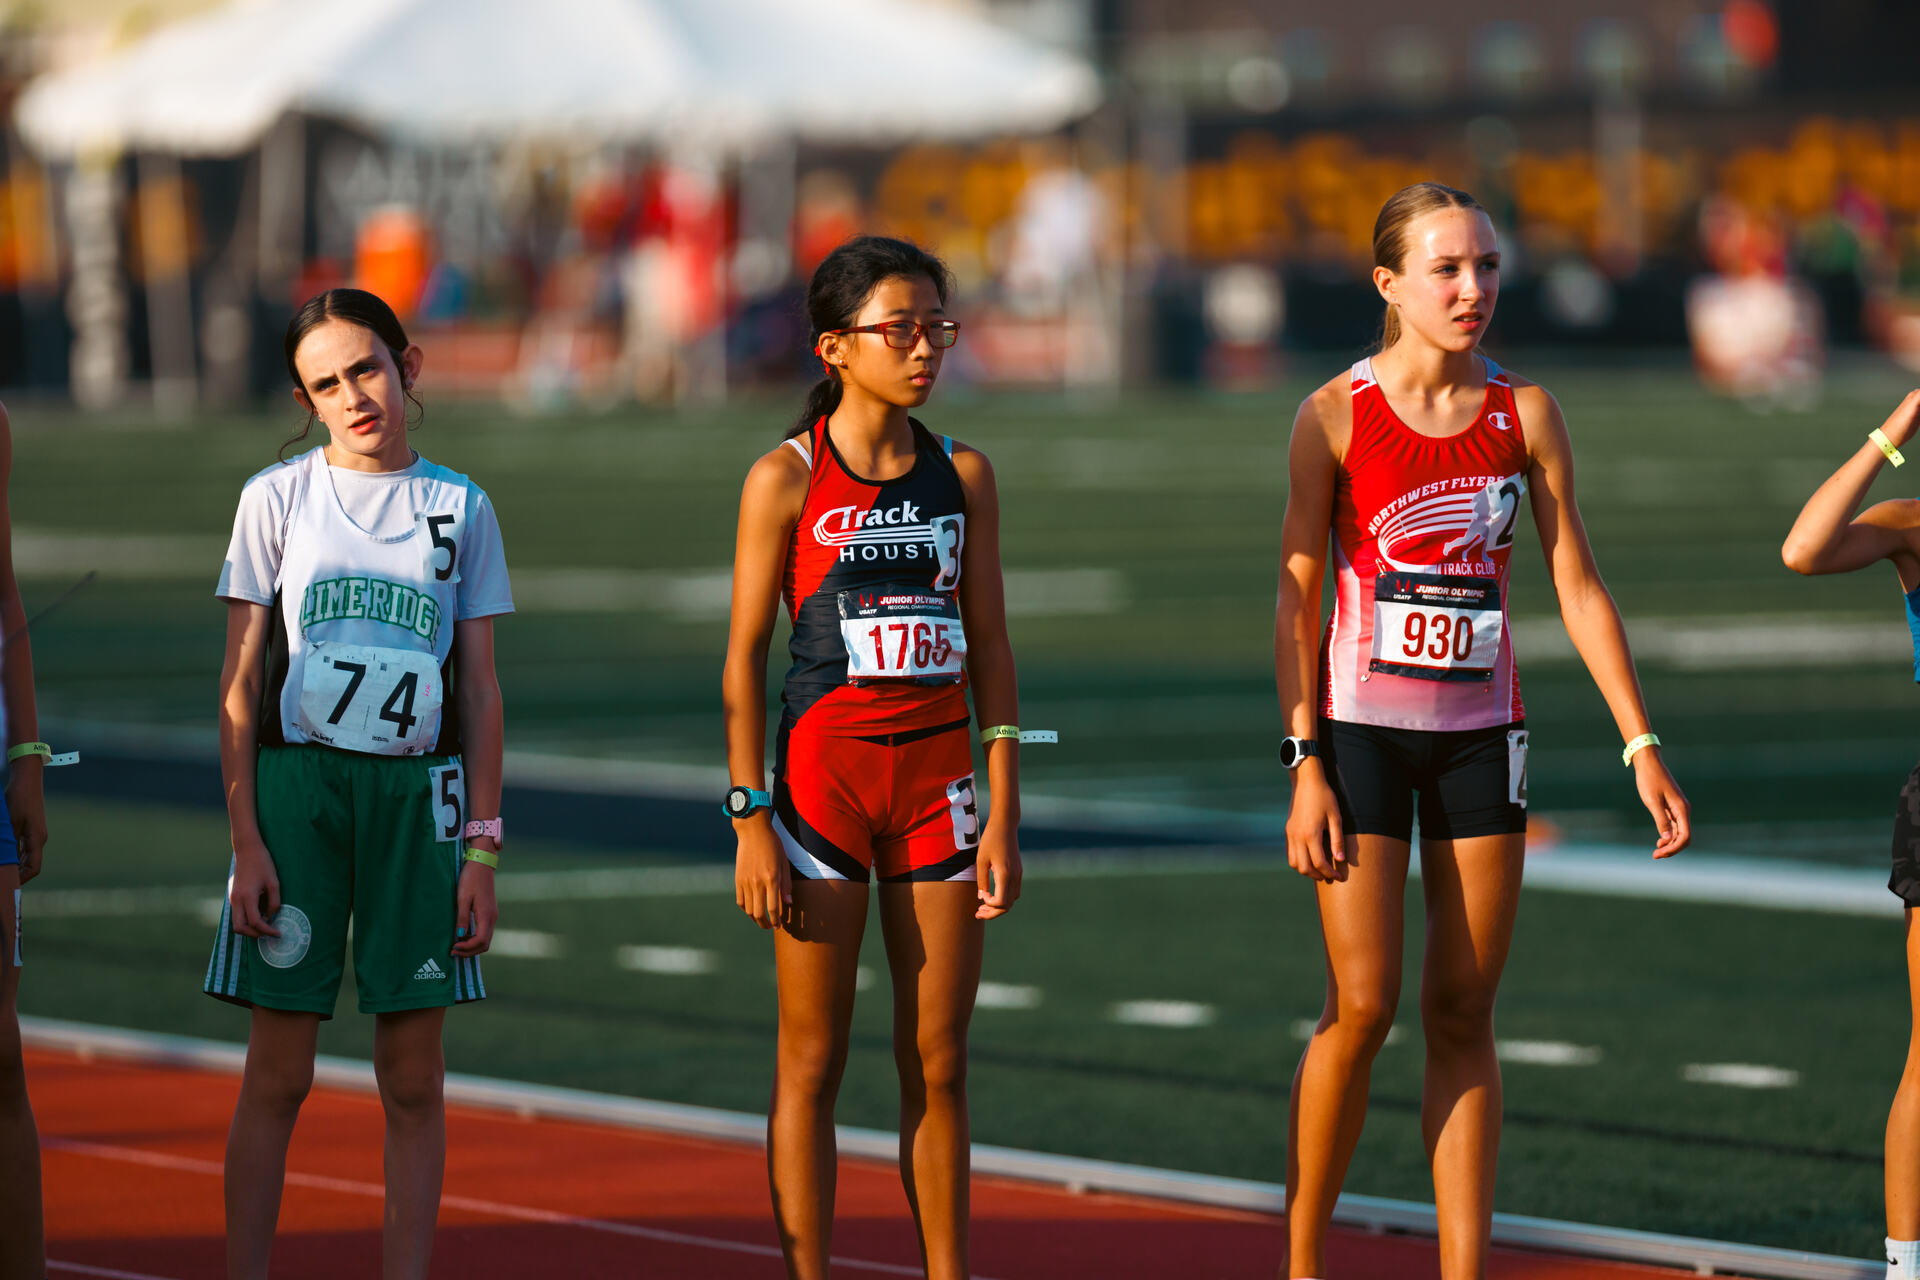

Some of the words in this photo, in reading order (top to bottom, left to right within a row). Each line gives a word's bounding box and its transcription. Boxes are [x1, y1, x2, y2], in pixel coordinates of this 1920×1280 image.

[813, 500, 920, 530] Track
[1368, 480, 1449, 536] NORTHWEST
[1496, 482, 1520, 547] 2
[427, 514, 457, 581] 5
[839, 543, 936, 562] HOUST
[942, 518, 960, 587] 3
[1443, 563, 1474, 575] TRACK
[1475, 562, 1496, 575] CLUB
[880, 596, 912, 604] JUNIOR
[914, 596, 945, 605] OLYMPIC
[1416, 585, 1449, 594] JUNIOR
[1451, 588, 1485, 597] OLYMPIC
[868, 623, 952, 670] 1765
[1402, 612, 1474, 661] 930
[440, 769, 462, 838] 5
[956, 778, 978, 844] 3
[413, 971, 447, 980] adidas
